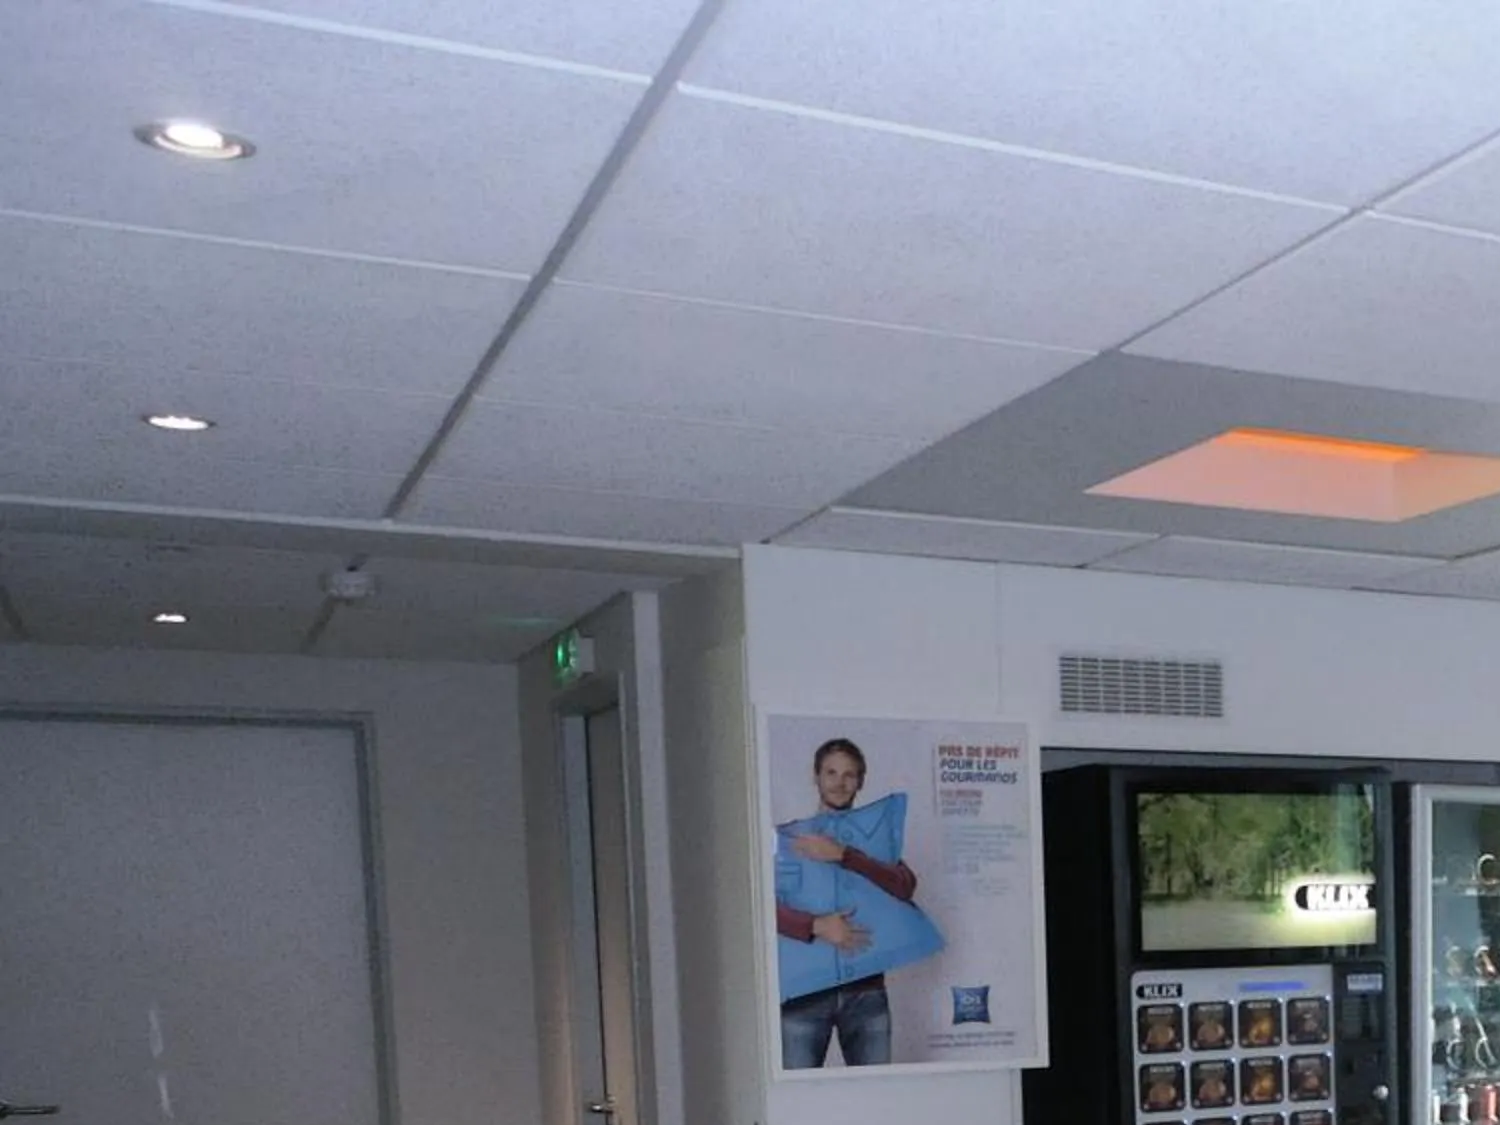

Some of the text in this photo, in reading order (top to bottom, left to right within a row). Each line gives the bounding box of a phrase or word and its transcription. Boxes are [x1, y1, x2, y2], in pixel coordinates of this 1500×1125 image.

[940, 758, 997, 771] POUR LES
[1306, 884, 1369, 910] KLIX
[1143, 985, 1179, 998] KLIX
